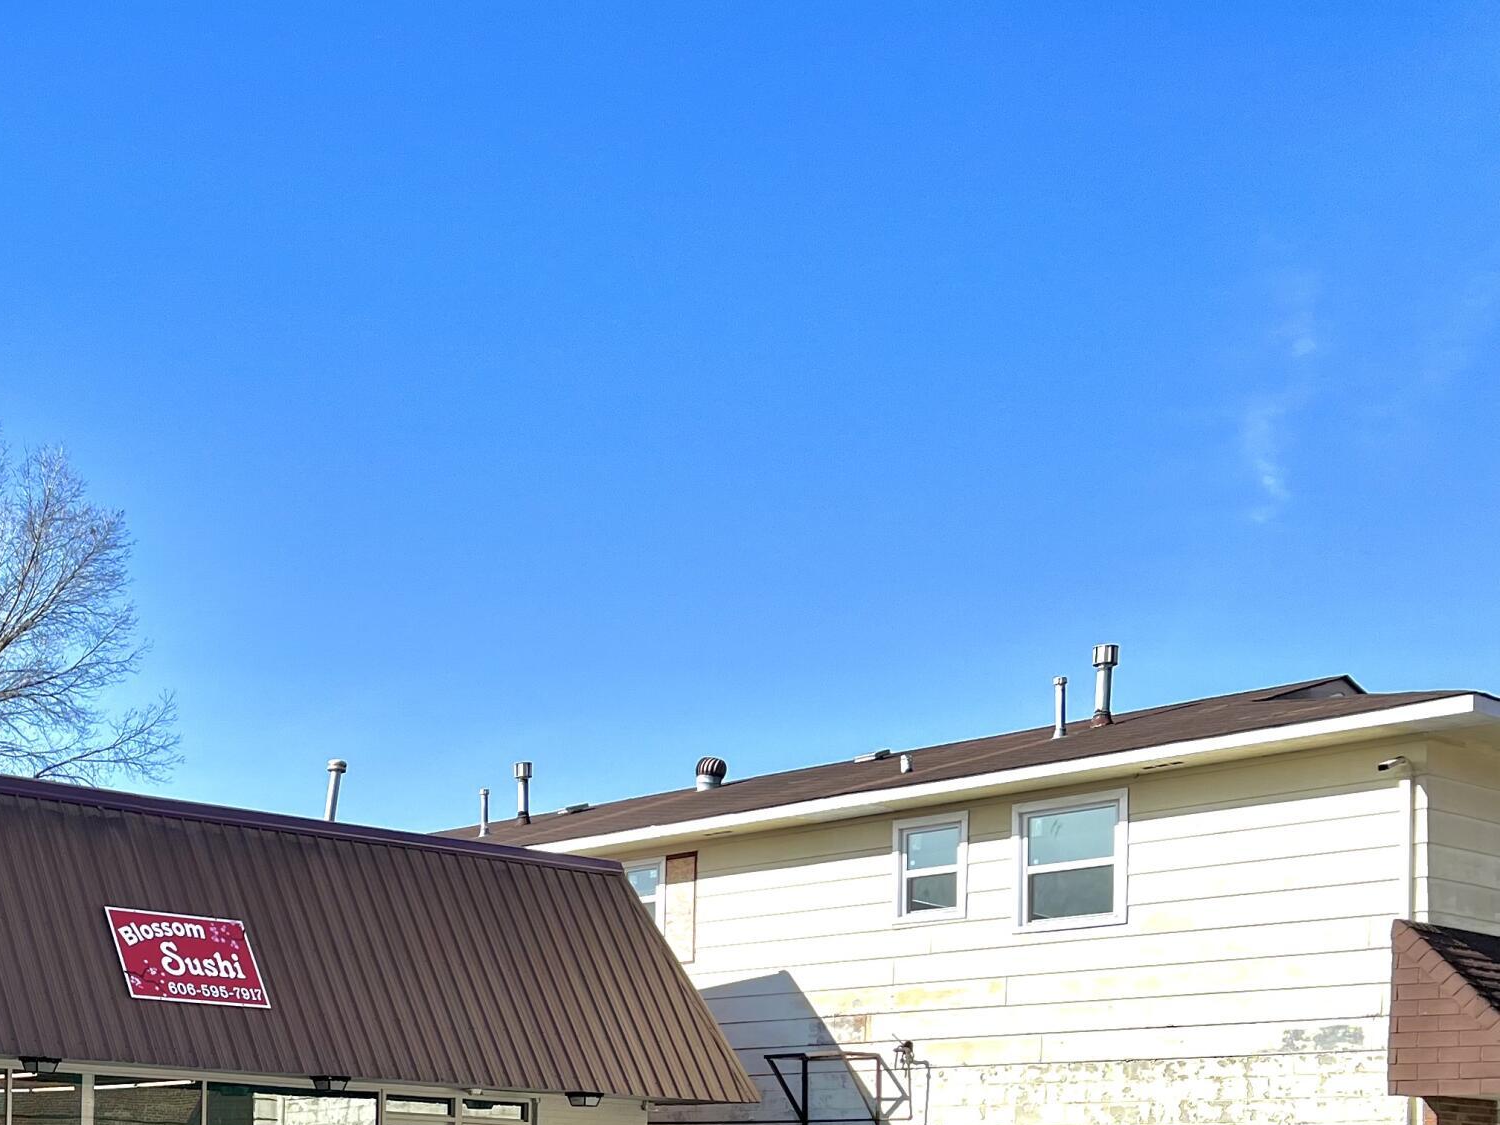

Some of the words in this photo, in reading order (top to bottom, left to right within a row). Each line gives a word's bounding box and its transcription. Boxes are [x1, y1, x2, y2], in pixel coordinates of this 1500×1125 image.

[117, 922, 206, 946] Blossom
[160, 941, 246, 979] Sushi
[168, 981, 262, 1001] 606-595-7917
